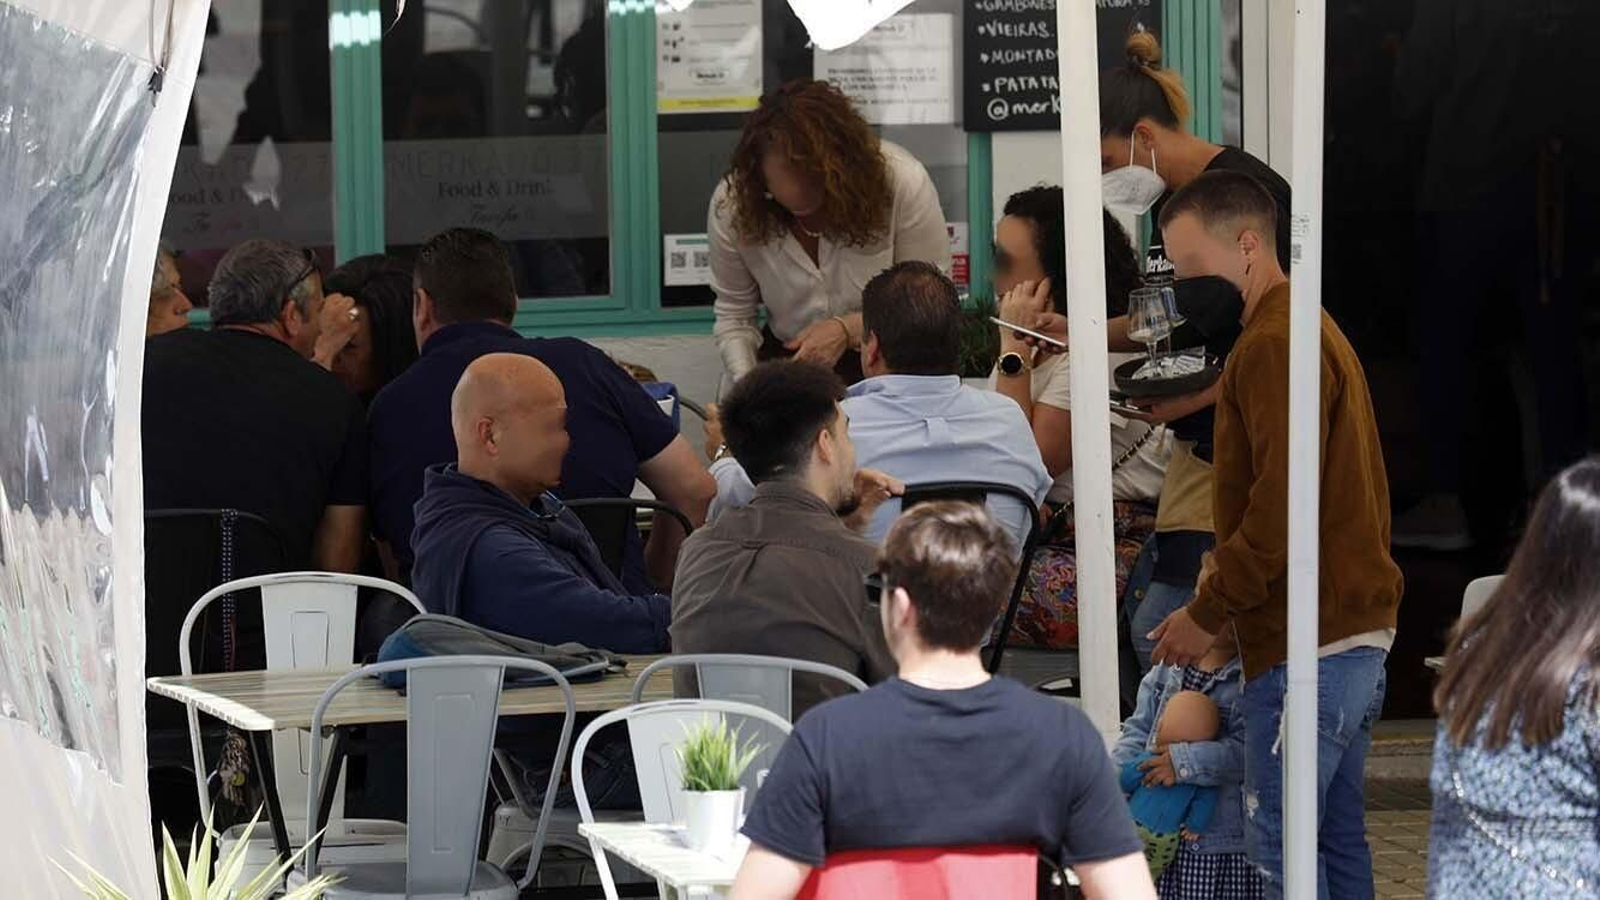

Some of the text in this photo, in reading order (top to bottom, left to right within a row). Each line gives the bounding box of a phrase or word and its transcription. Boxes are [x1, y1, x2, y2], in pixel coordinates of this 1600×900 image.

[991, 48, 1058, 64] MONTAD
[994, 77, 1059, 94] PATATA
[987, 95, 1062, 120] @merk
[170, 188, 206, 203] ood
[438, 180, 482, 199] Food
